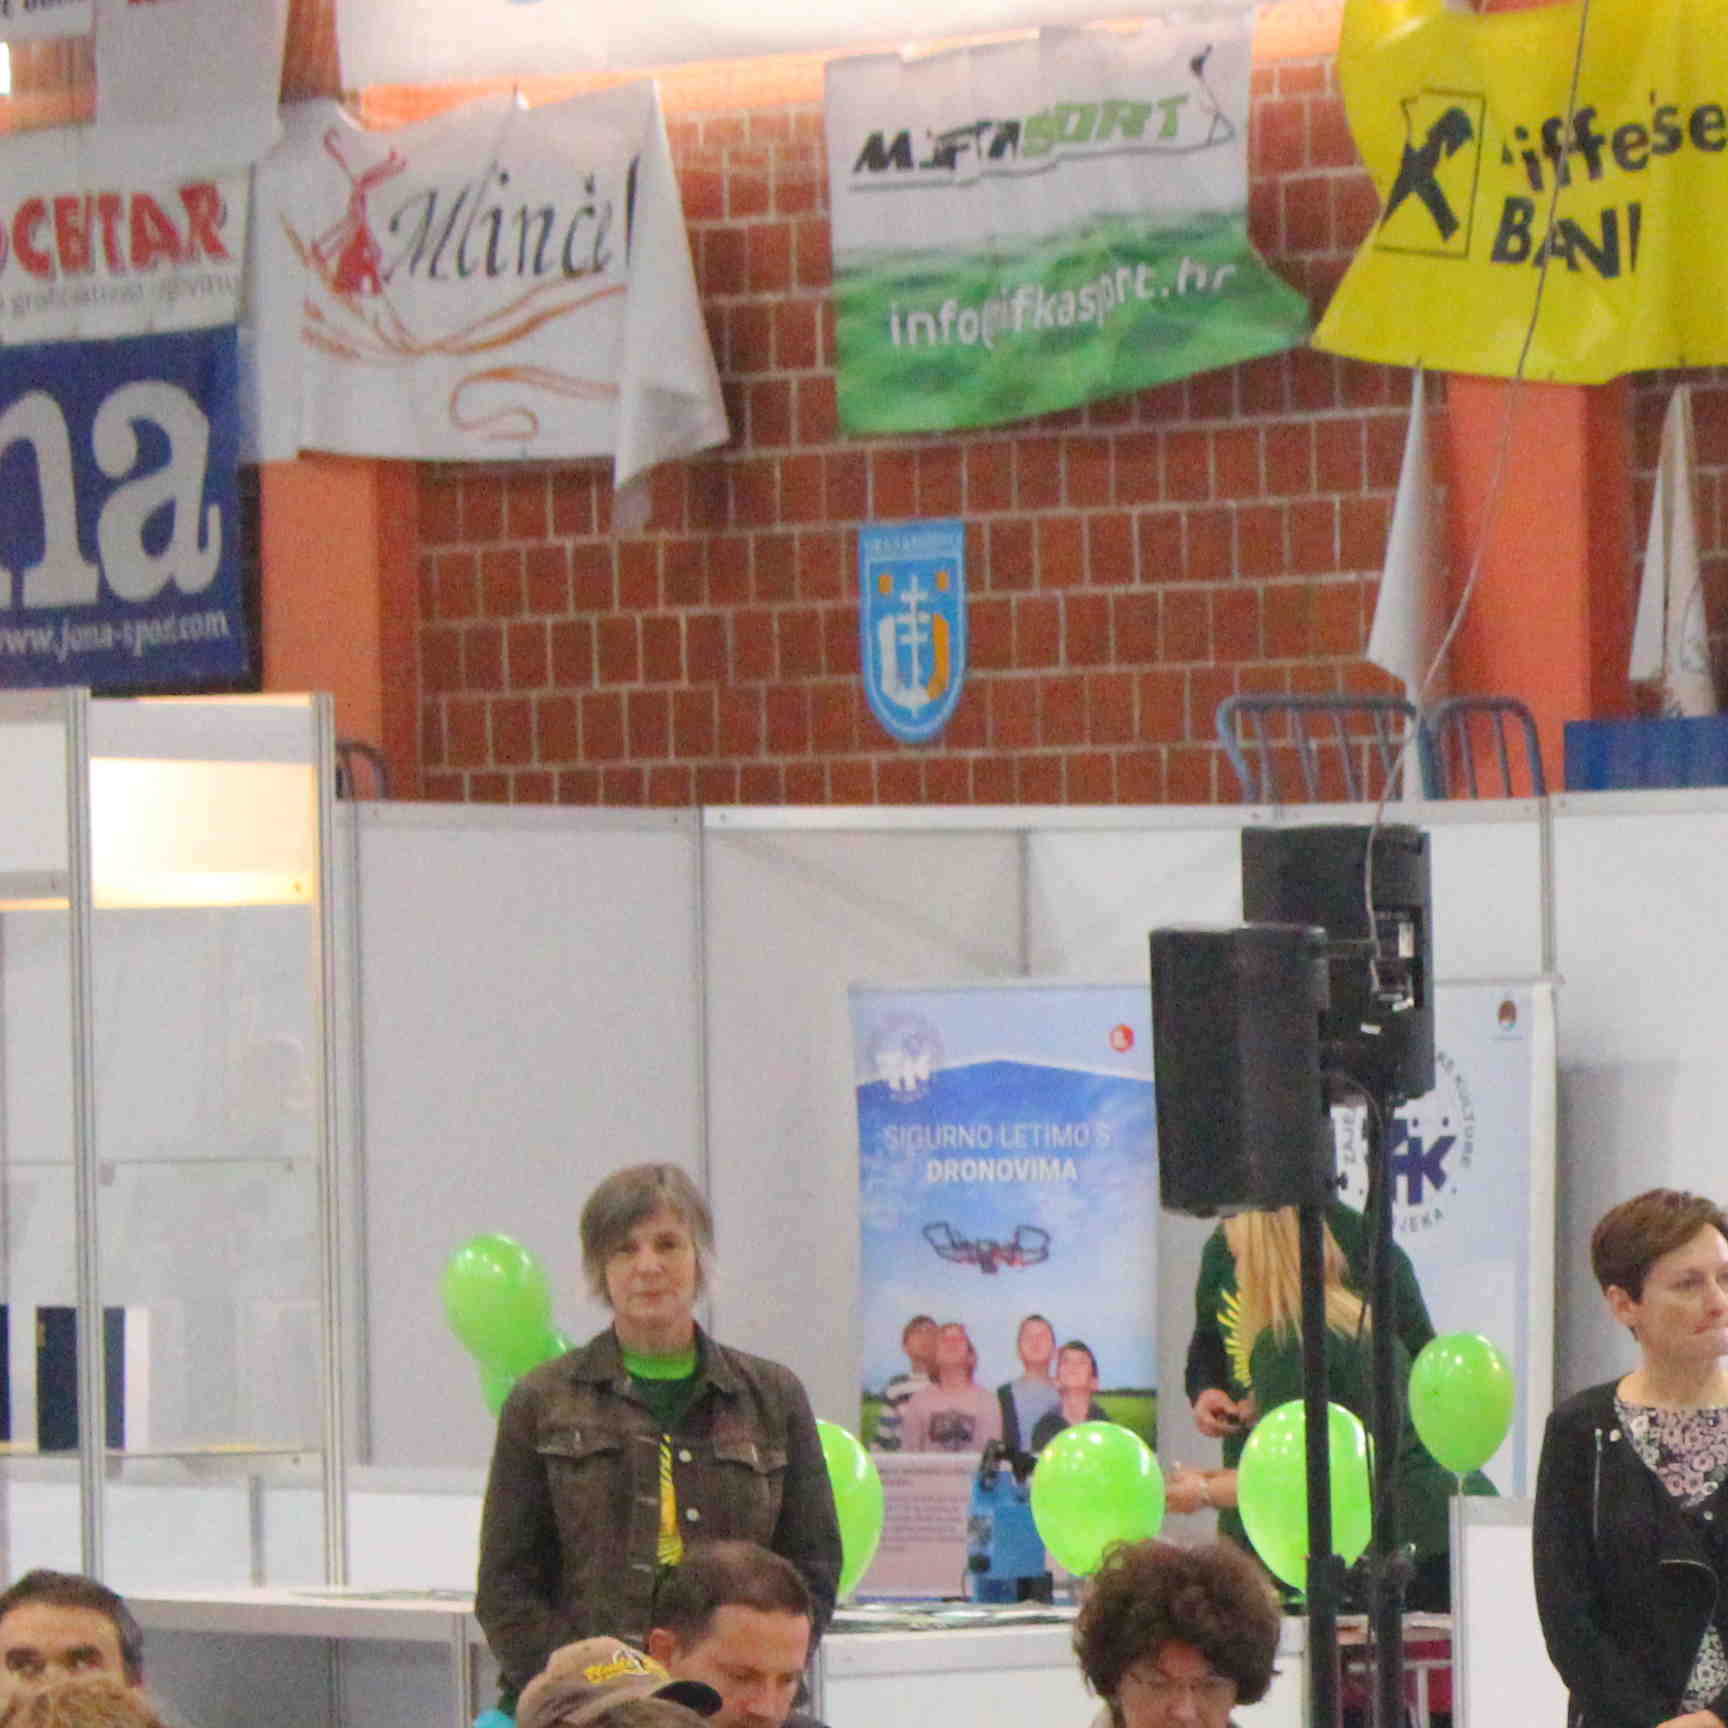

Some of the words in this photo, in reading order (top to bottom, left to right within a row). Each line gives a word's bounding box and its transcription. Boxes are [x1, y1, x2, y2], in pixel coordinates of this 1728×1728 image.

[883, 1122, 993, 1151] SIGURNO
[1000, 1121, 1091, 1149] LETIMO
[927, 1156, 1079, 1184] DRONOVIMA
